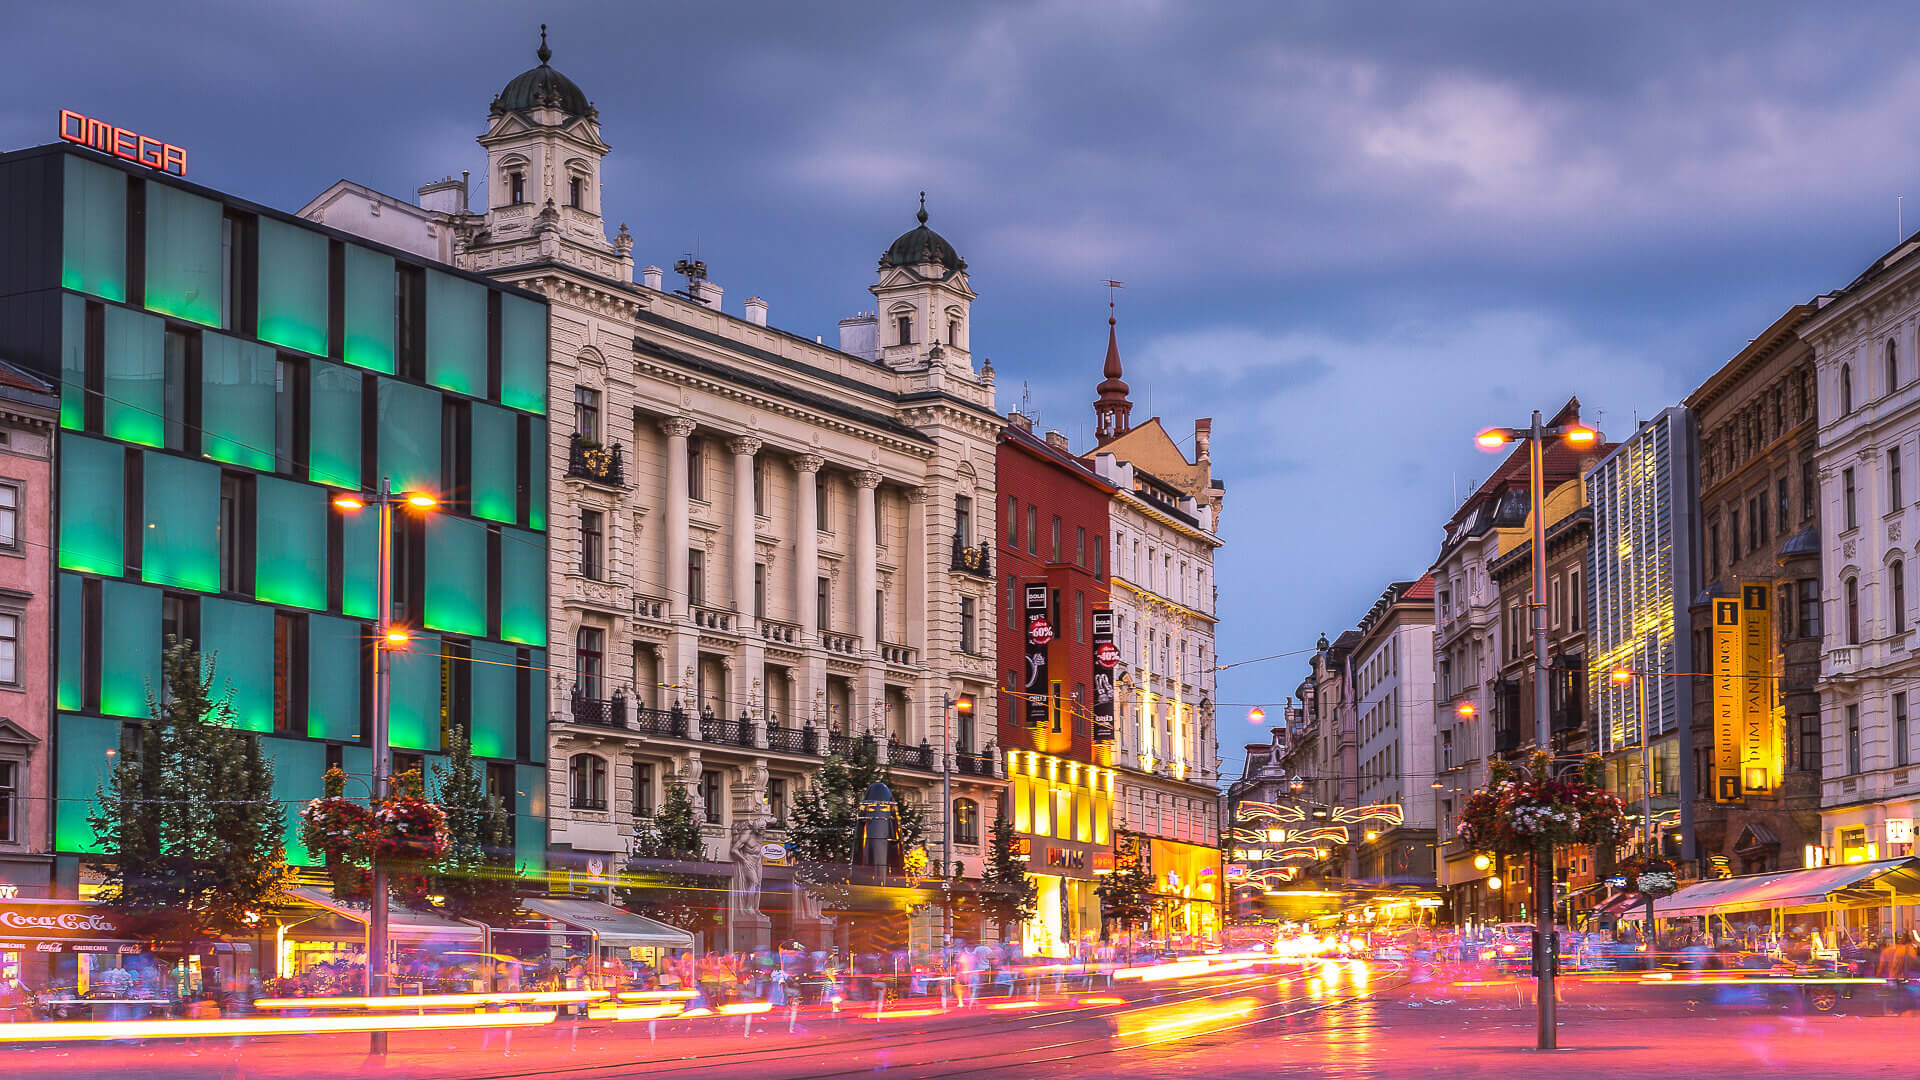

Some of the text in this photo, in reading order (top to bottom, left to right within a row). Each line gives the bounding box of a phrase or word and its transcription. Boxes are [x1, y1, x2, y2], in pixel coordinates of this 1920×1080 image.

[59, 109, 187, 176] OMEGA
[1029, 627, 1053, 637] -60%
[1719, 638, 1731, 691] AGENCY
[0, 911, 118, 932] Coca-Cola
